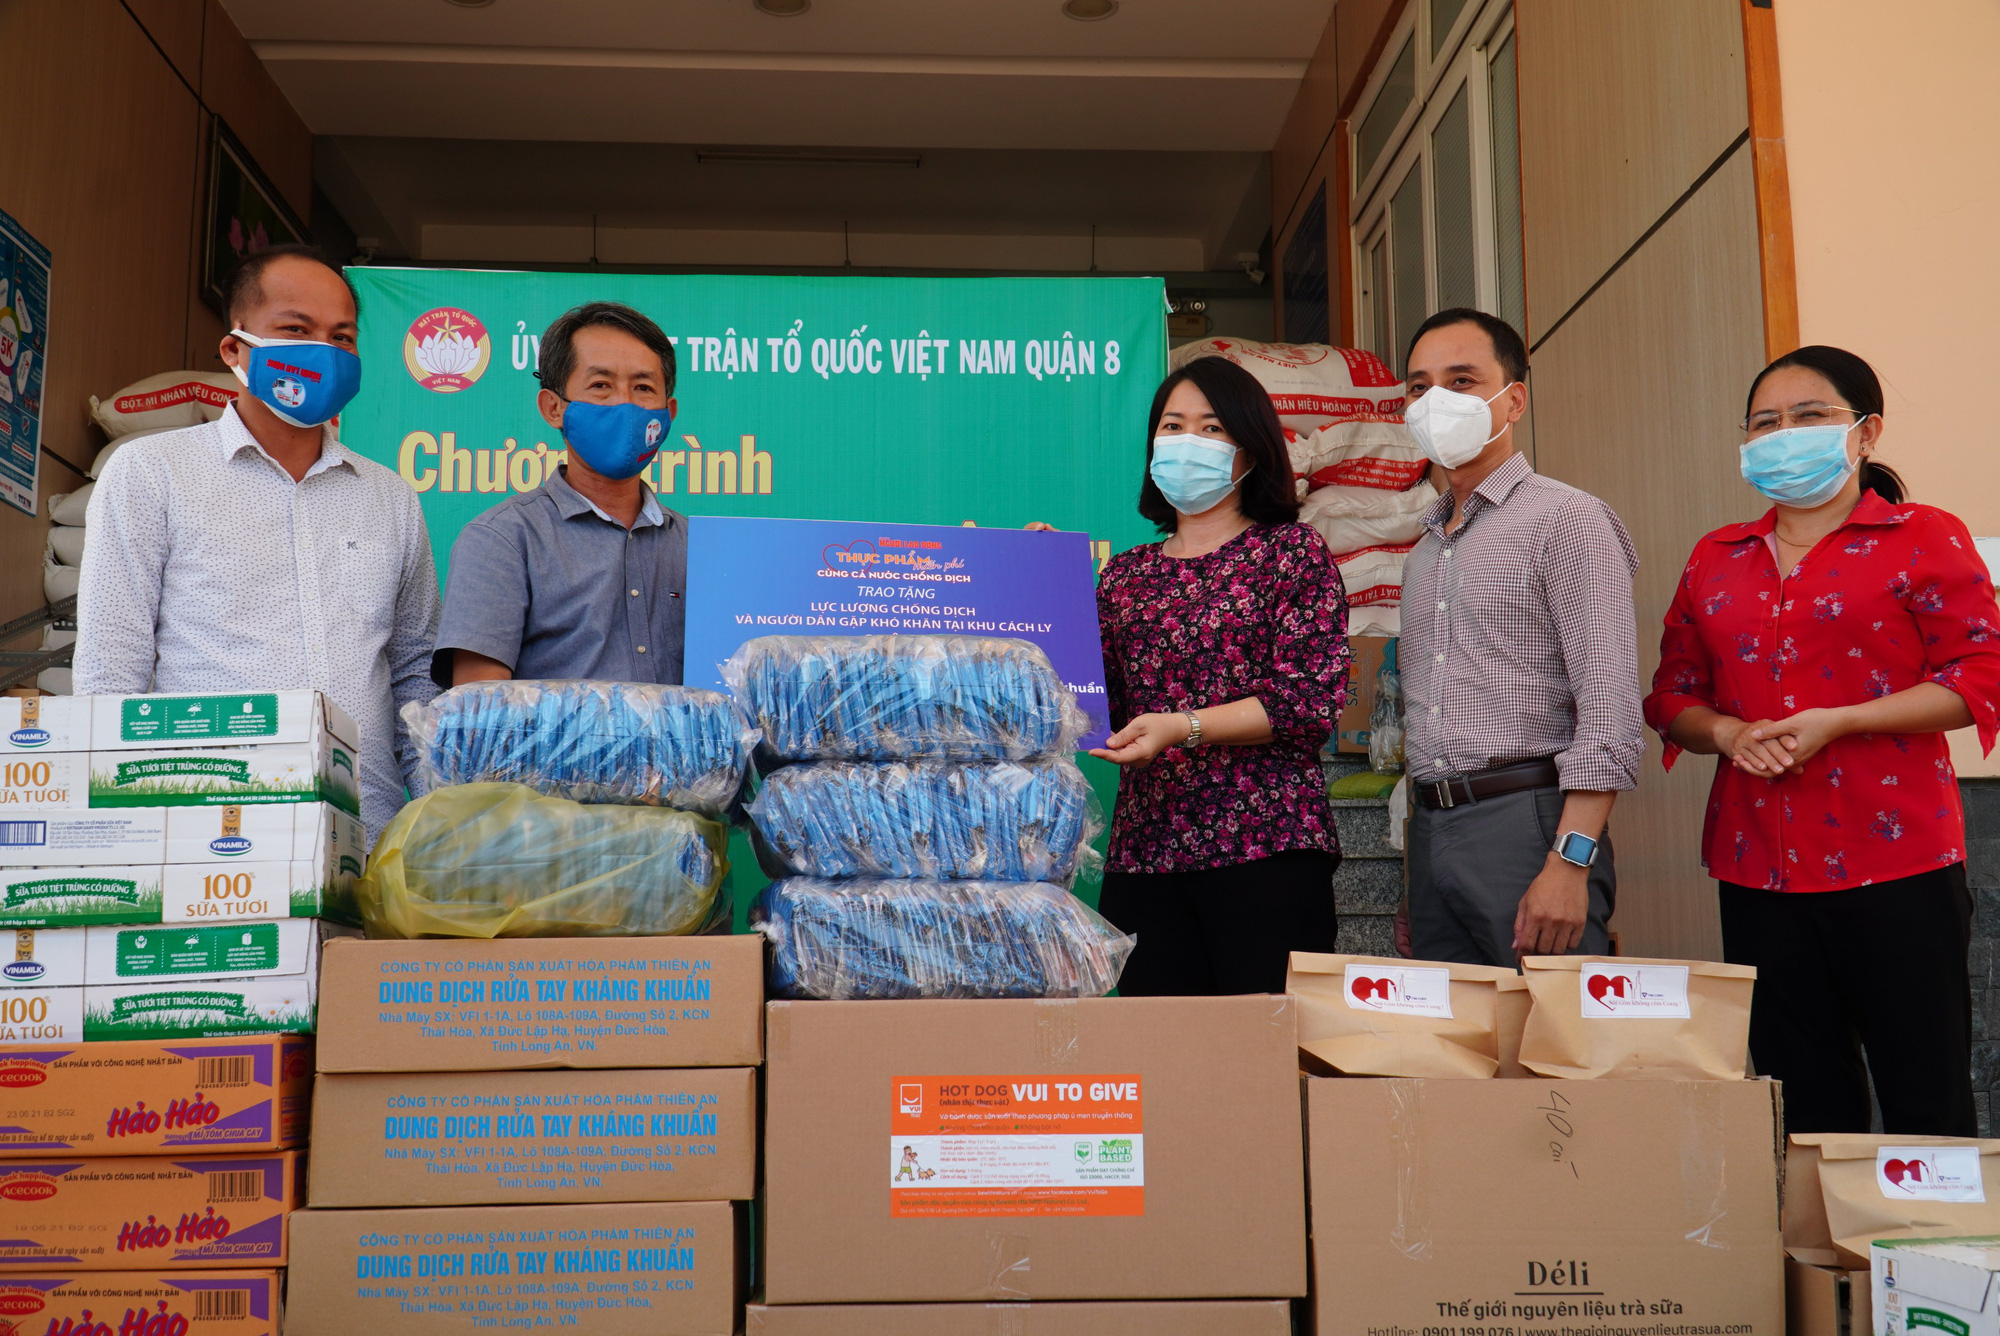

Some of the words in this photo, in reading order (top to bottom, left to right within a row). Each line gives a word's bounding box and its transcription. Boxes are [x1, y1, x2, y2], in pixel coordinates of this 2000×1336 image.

[687, 327, 758, 380] TRẬN
[767, 319, 803, 373] TỔ
[811, 325, 882, 380] QUỐC
[890, 329, 949, 381] VIỆT
[959, 339, 1016, 375] NAM
[1024, 331, 1095, 382] QUẬN
[1104, 340, 1121, 375] 8
[1297, 398, 1319, 412] HIỆU
[1322, 400, 1352, 413] HOÀNG
[1380, 401, 1391, 412] 40
[397, 430, 568, 493] Chươn
[836, 551, 881, 566] THỰC
[884, 550, 931, 565] PHẨM
[817, 569, 849, 578] CÙNG
[851, 568, 866, 579] CẢ
[869, 570, 900, 580] NƯỚC
[903, 570, 943, 582] CHỐNG
[945, 574, 971, 584] DỊCH
[857, 585, 895, 598] TRAO
[898, 585, 935, 600] TẶNG
[811, 601, 837, 614] LỰC
[840, 602, 888, 615] LƯỢNG
[891, 602, 940, 616] CHỐNG
[943, 606, 976, 617] DỊCH
[735, 613, 753, 625] VÀ
[757, 614, 803, 625] NGƯỜI
[806, 614, 836, 626] DÂN
[839, 617, 867, 629] GẶP
[870, 617, 900, 628] KHÓ
[903, 618, 941, 630] KHĂN
[944, 620, 964, 632] TẠI
[968, 621, 995, 631] KHU
[999, 620, 1035, 632] CÁCH
[1038, 623, 1052, 632] LY
[12, 732, 48, 741] VINAMILK
[126, 764, 140, 775] SỮA
[142, 763, 159, 773] TƯƠI
[161, 761, 174, 771] TIỆT
[176, 761, 201, 771] TRÙNG
[204, 761, 214, 771] CÓ
[215, 762, 241, 774] ĐƯỜNG
[212, 841, 249, 849] VINAMILK
[186, 901, 220, 917] SỮA
[224, 900, 268, 914] TƯƠI
[381, 959, 420, 973] CÔNG
[425, 961, 441, 972] TY
[651, 958, 689, 970] THIÊN
[694, 960, 711, 970] AN
[379, 981, 433, 1003] DUNG
[440, 981, 485, 1008] DỊCH
[491, 973, 530, 1002] RỬA
[536, 980, 567, 1001] TAY
[573, 975, 639, 1001] KHÁNG
[645, 970, 710, 1001] KHUẨN
[379, 1012, 403, 1023] Nhà
[406, 1012, 430, 1025] Máy
[434, 1011, 455, 1022] SX:
[517, 1010, 532, 1021] Lô
[605, 1010, 647, 1023] Đường
[650, 1007, 665, 1019] Số
[669, 1009, 679, 1020] 2,
[683, 1009, 710, 1019] KCN
[53, 1060, 68, 1068] SẢN
[69, 1058, 89, 1068] PHẨM
[91, 1059, 103, 1068] VỚI
[104, 1059, 124, 1067] CÔNG
[125, 1058, 145, 1067] NGHỆ
[147, 1058, 166, 1067] NHẬT
[168, 1057, 183, 1066] BẢN
[940, 1085, 970, 1096] HOT
[975, 1085, 1008, 1097] DOG
[1011, 1083, 1048, 1101] VUI
[1055, 1082, 1082, 1101] TO
[1090, 1083, 1138, 1101] GIVE
[107, 1101, 161, 1138] Hảo
[165, 1092, 220, 1130] Hảo
[1099, 1146, 1132, 1155] PLANT
[1099, 1153, 1132, 1162] BASED
[1528, 1259, 1589, 1286] Déli
[1436, 1299, 1471, 1317] Thế
[1474, 1300, 1507, 1320] giới
[1512, 1302, 1578, 1320] nguyên
[1583, 1301, 1616, 1320] liệu
[1620, 1299, 1645, 1315] trà
[1650, 1299, 1683, 1315] sữa
[1423, 1327, 1455, 1336] 0901
[1460, 1326, 1489, 1336] 199
[1492, 1326, 1513, 1336] 076
